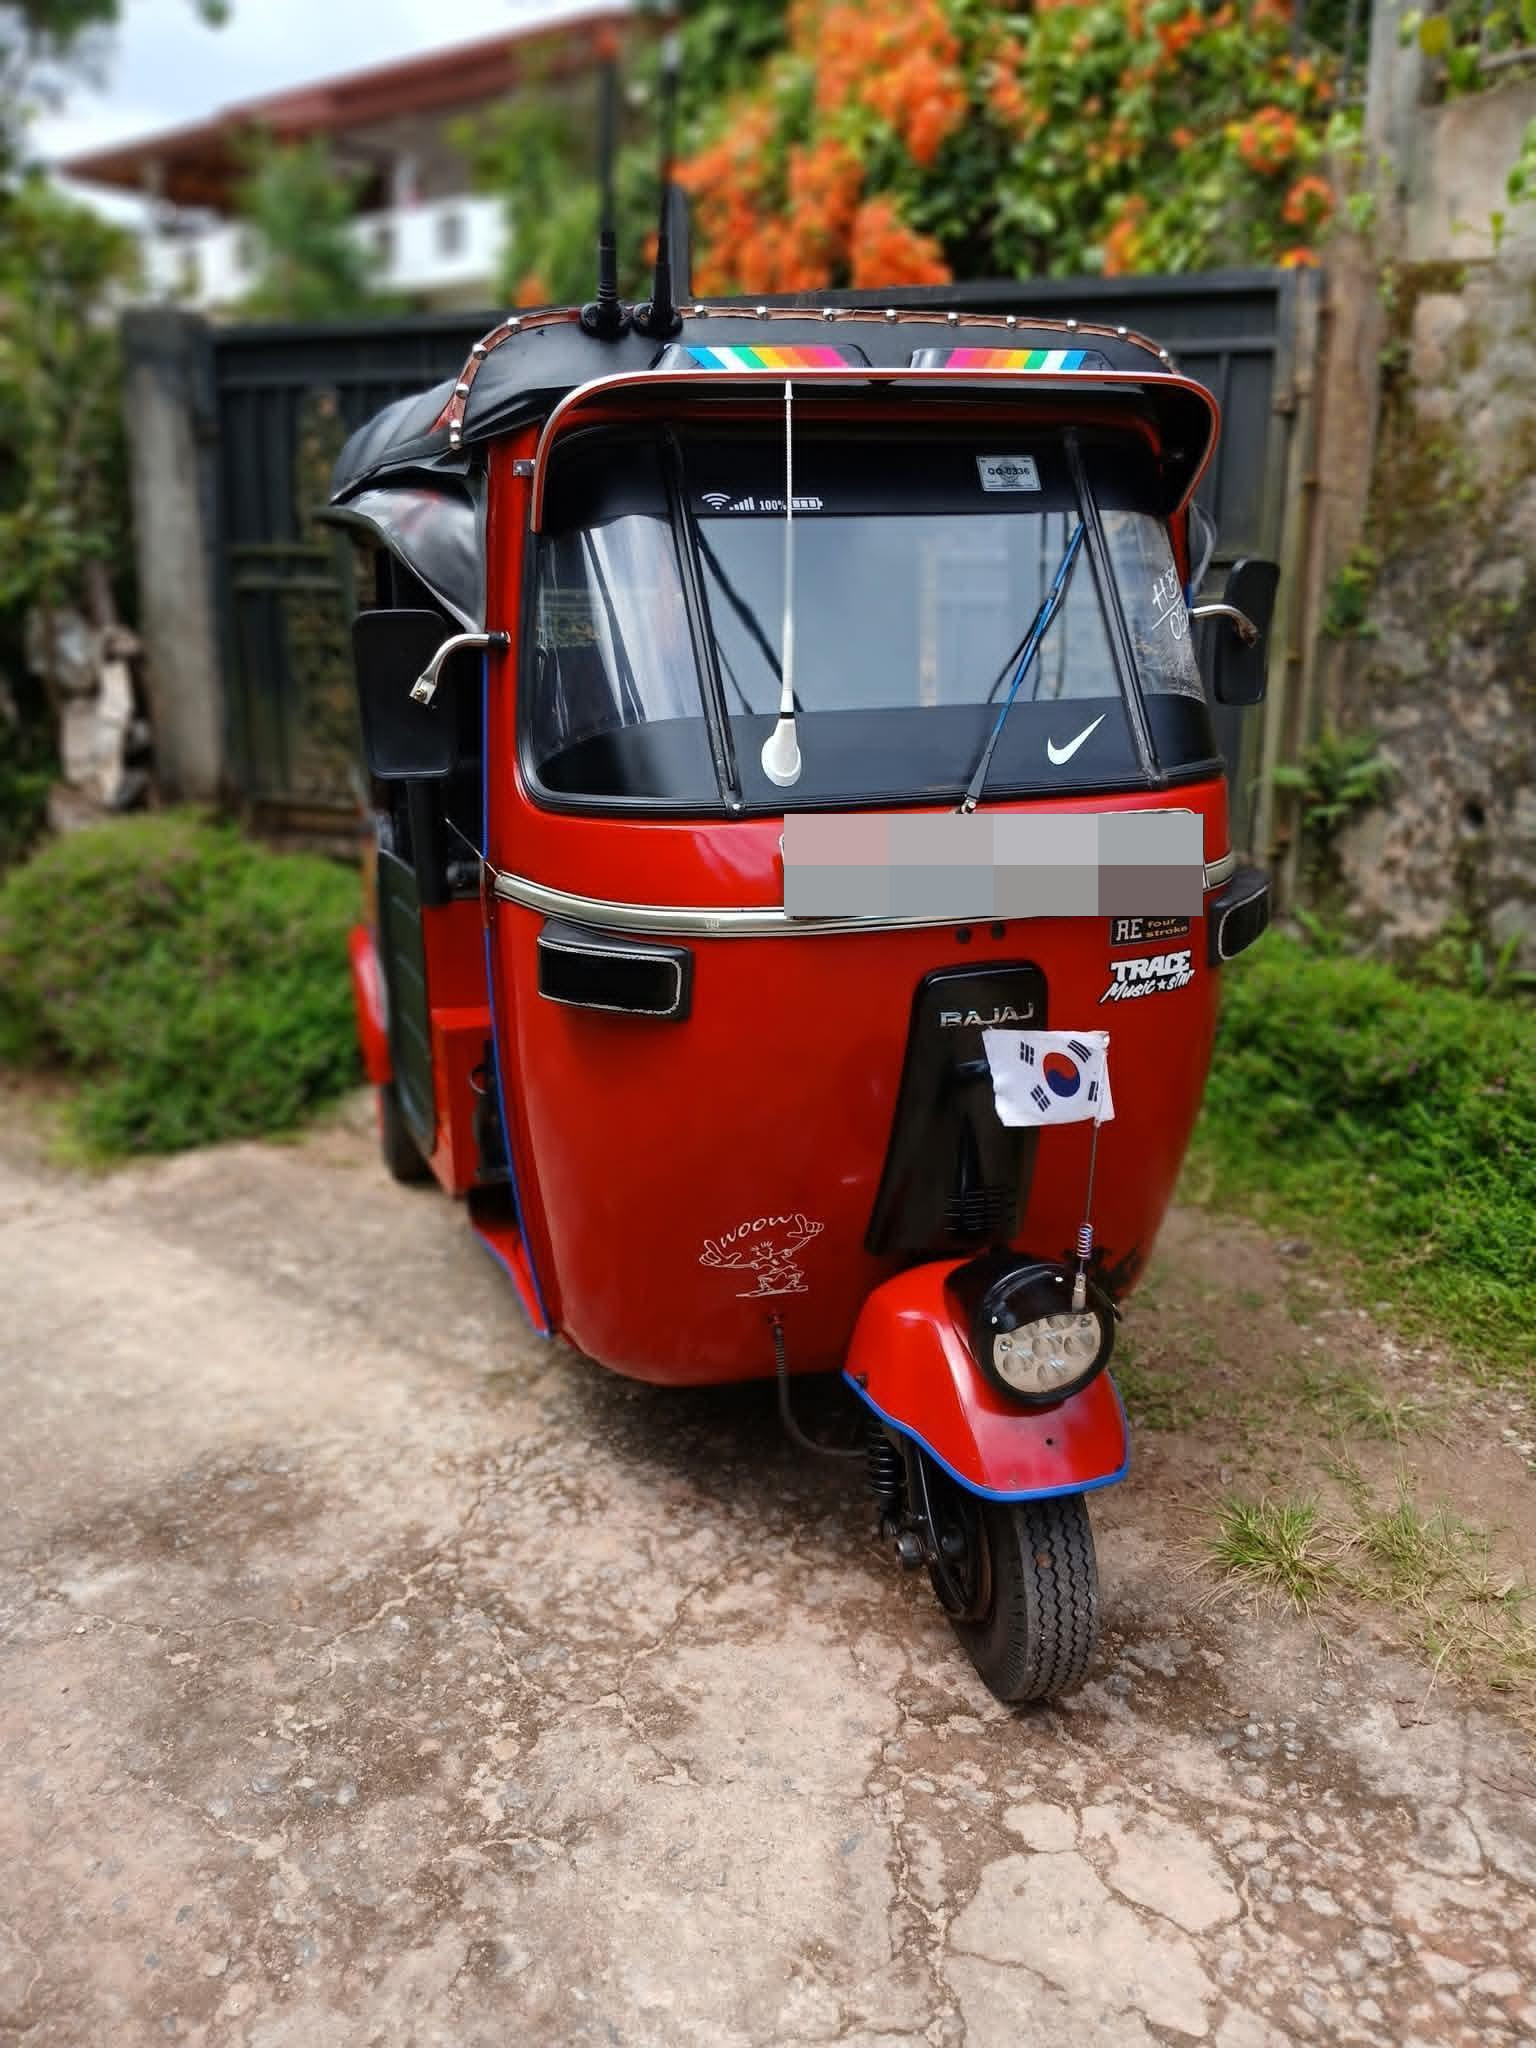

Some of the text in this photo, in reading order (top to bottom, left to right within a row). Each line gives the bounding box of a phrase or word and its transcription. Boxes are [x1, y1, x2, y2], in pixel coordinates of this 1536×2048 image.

[1115, 918, 1144, 941] RE
[1145, 926, 1188, 938] stroke
[1147, 918, 1177, 929] four
[1110, 949, 1192, 983] TRACE
[1100, 979, 1157, 1003] Music
[940, 1002, 1035, 1027] BAJAJ
